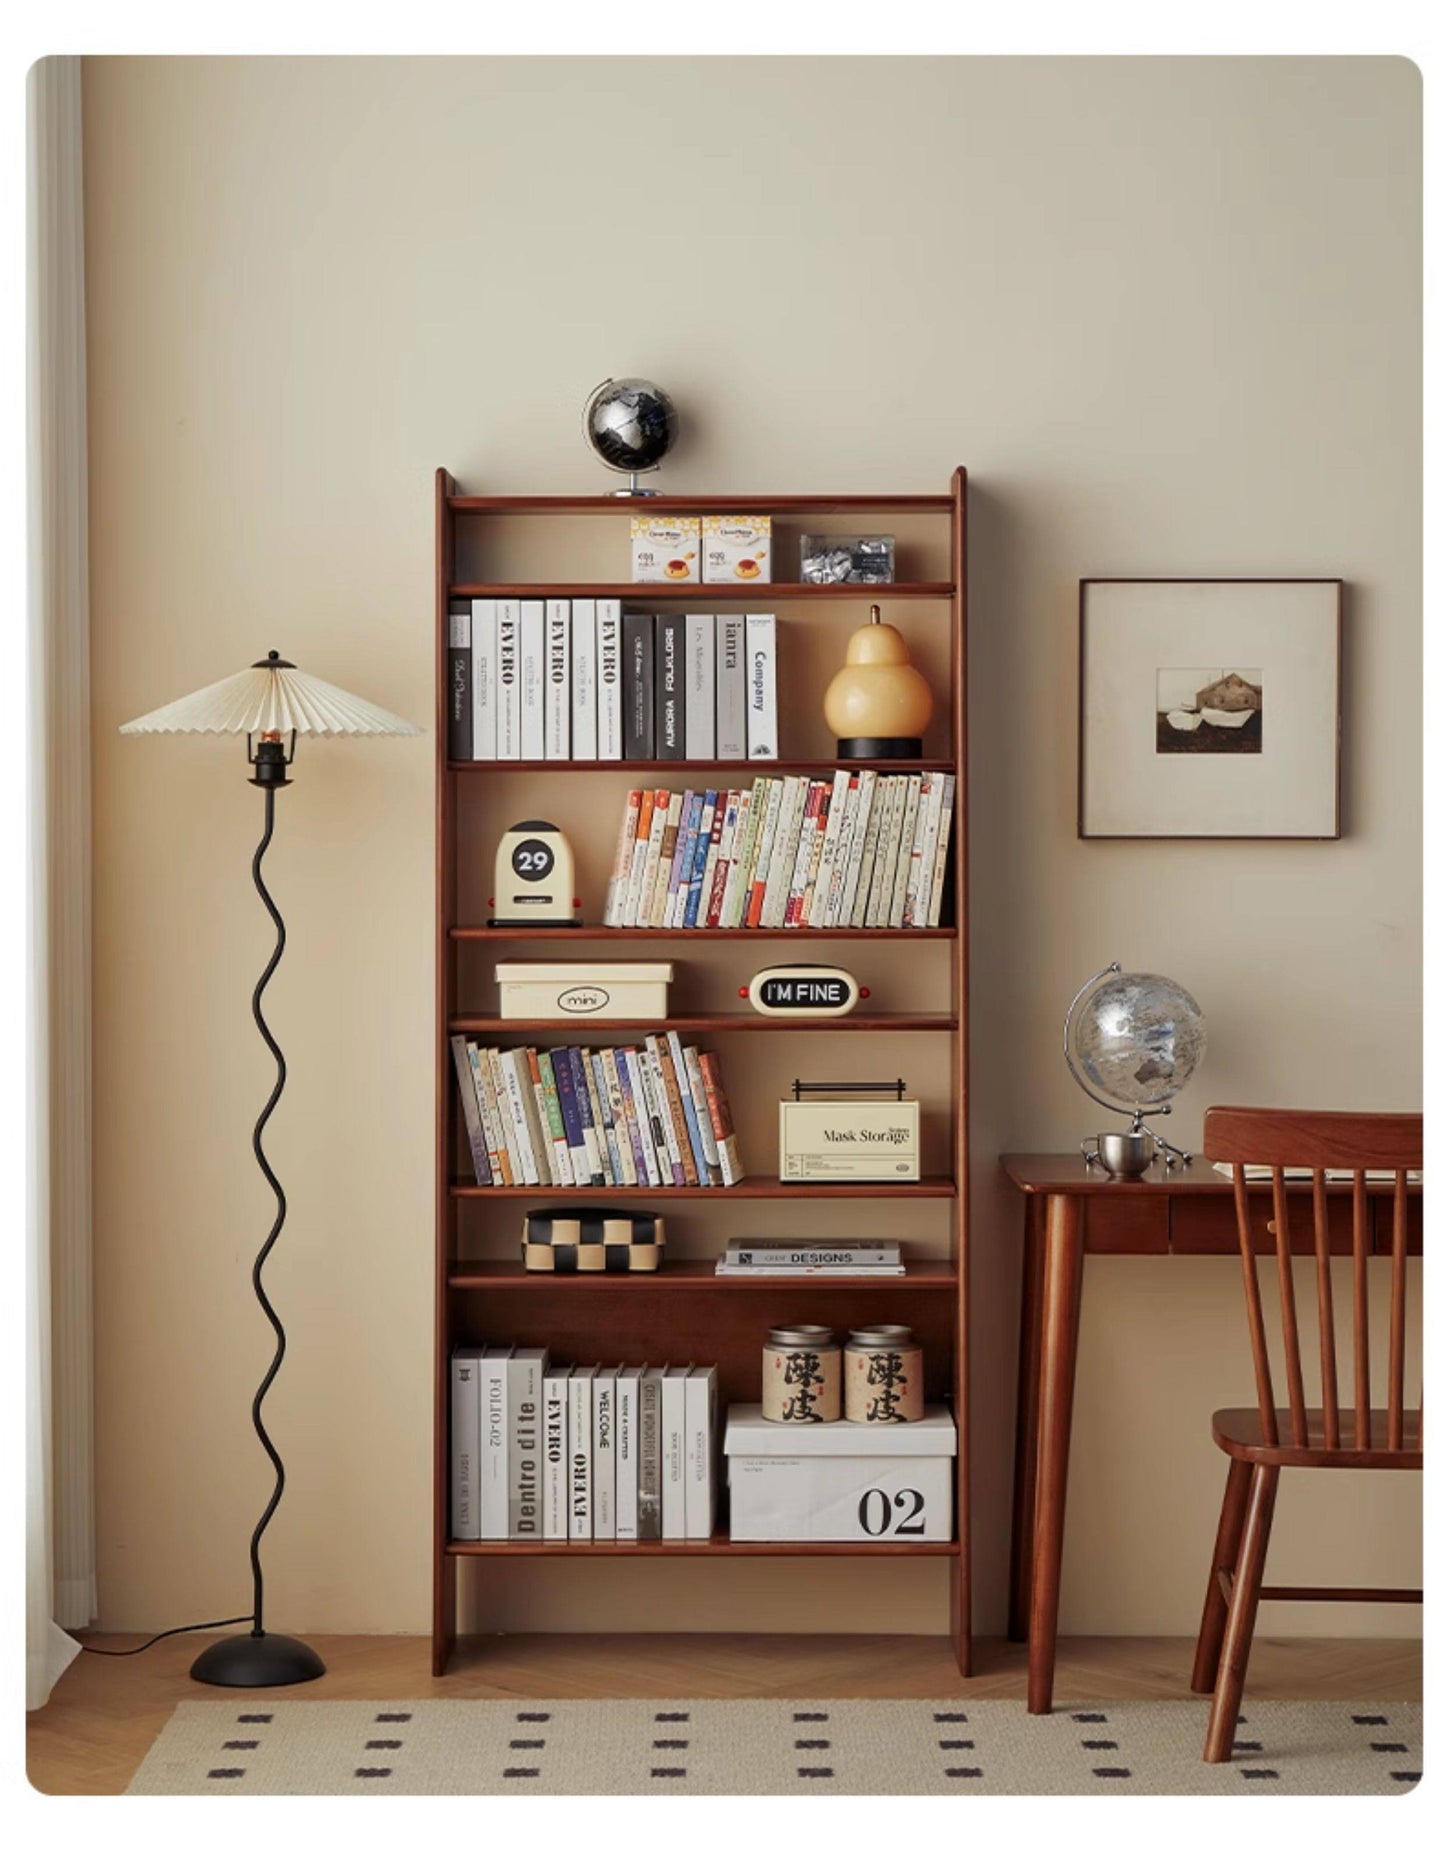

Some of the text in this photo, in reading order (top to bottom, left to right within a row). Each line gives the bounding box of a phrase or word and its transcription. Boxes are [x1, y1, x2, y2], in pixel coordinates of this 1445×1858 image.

[500, 621, 515, 685] EVERO
[551, 621, 565, 684] EVERO
[602, 621, 617, 684] EVERO
[726, 622, 741, 670] ianra
[665, 627, 675, 748] AURORA FOLKLORE
[753, 651, 767, 711] Company
[518, 851, 548, 872] 29
[567, 992, 598, 1005] mini
[767, 983, 841, 1001] I'M FINE
[824, 1129, 910, 1145] Mask Storage
[791, 1252, 853, 1263] DESIGNS
[489, 1378, 502, 1448] FOLIO-02
[548, 1399, 561, 1463] EVERO
[599, 1390, 610, 1449] WELCOME
[517, 1402, 536, 1533] Dentro di te
[573, 1453, 587, 1517] EVERO
[858, 1487, 927, 1537] 02
